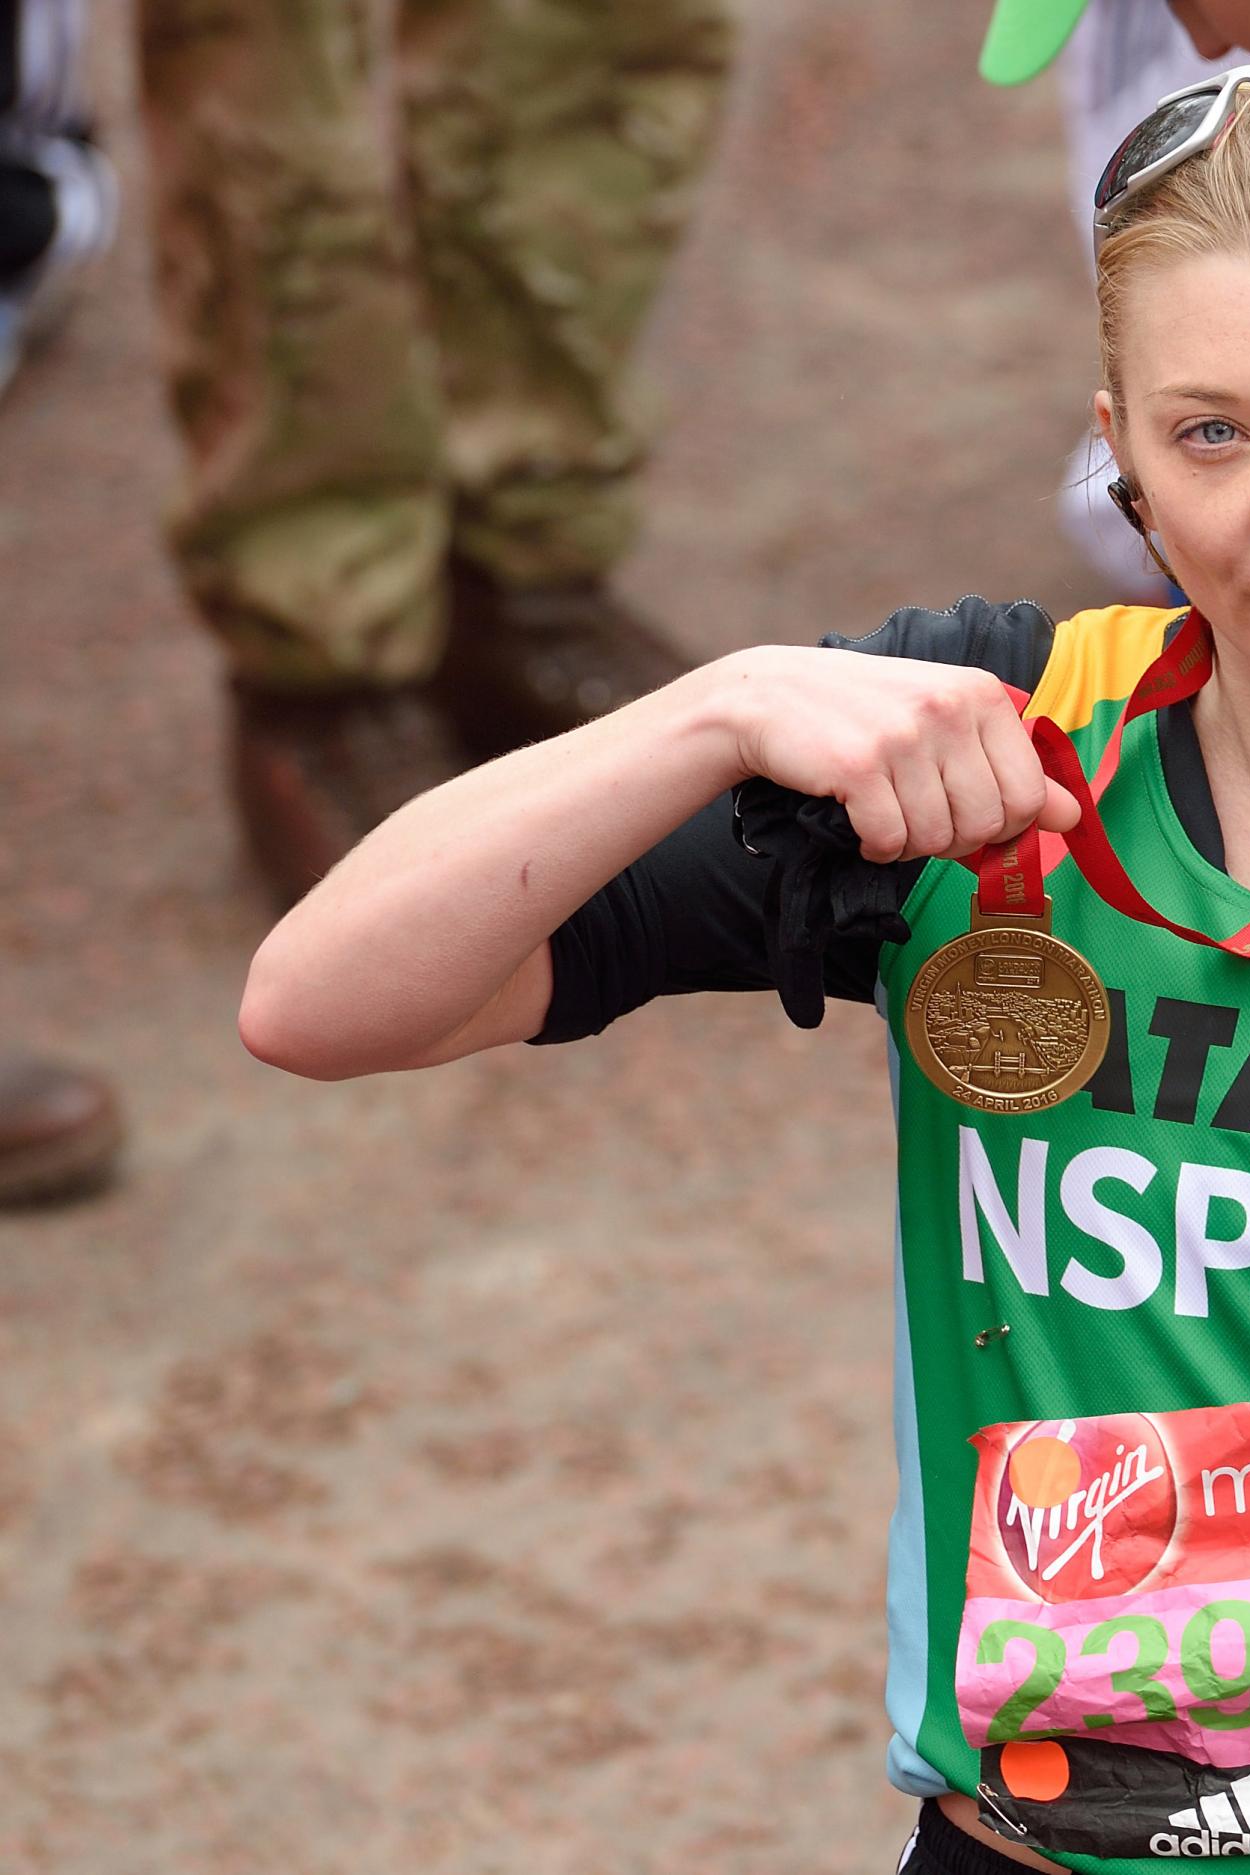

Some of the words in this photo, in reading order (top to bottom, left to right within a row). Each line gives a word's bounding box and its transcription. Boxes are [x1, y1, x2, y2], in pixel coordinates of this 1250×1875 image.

[911, 964, 941, 1012] VIRGIN
[937, 935, 987, 968] MONEY
[990, 932, 1056, 954] LONDON
[1055, 947, 1106, 1022] MARATHON
[951, 1085, 972, 1101] 24
[972, 1095, 1021, 1112] APRIL
[1022, 1089, 1059, 1111] 2016
